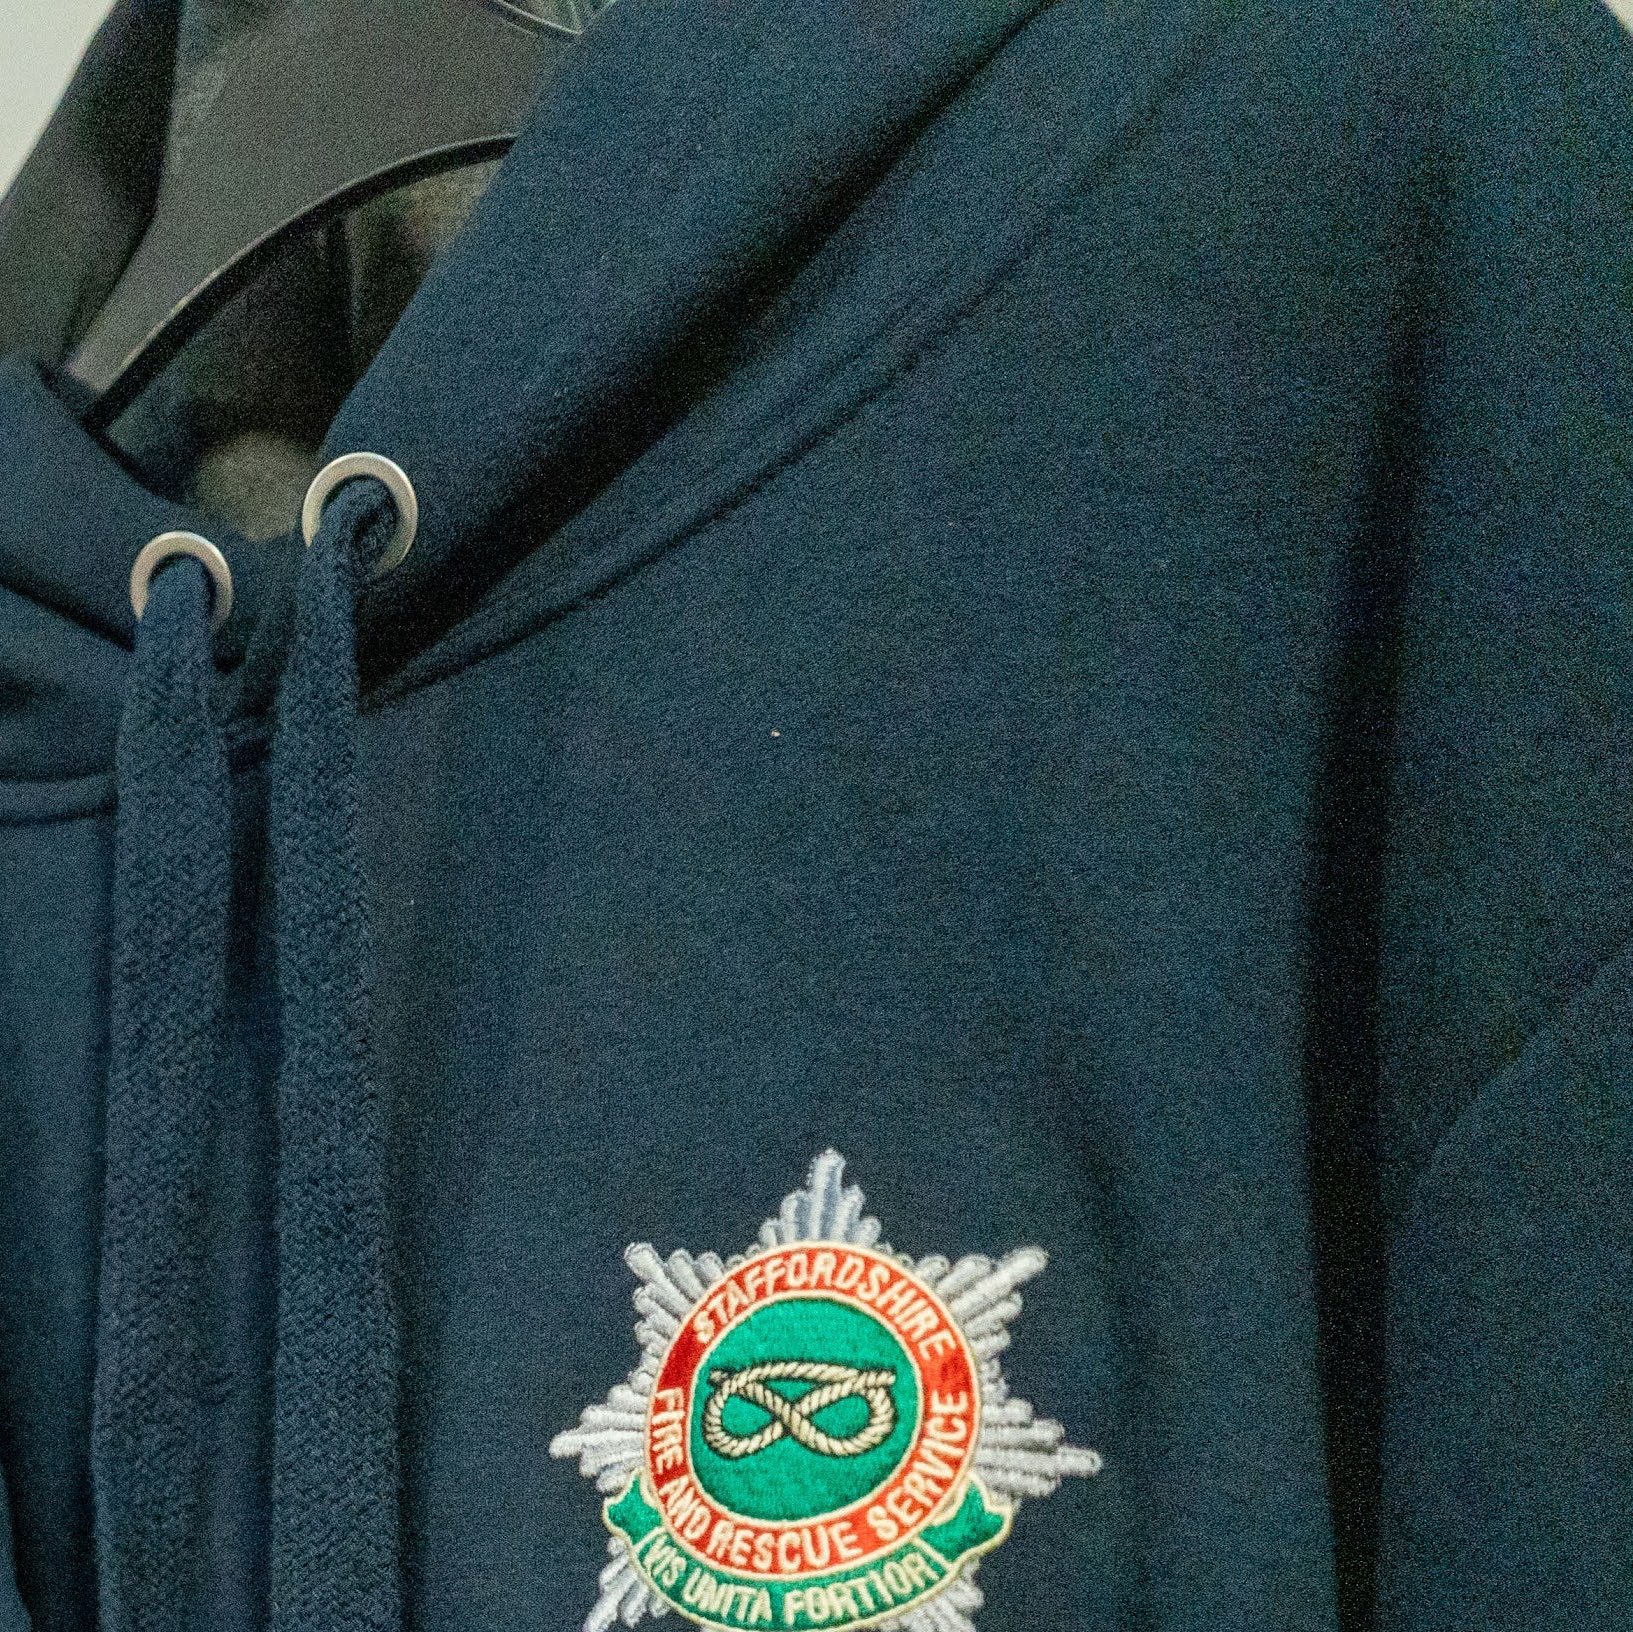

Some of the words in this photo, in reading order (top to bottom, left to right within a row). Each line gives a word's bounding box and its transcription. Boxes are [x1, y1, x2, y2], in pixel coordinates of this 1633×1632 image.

[693, 1252, 959, 1360] STAFFORDSHIRE
[654, 1388, 683, 1474] FIRE
[865, 1388, 969, 1540] SERVICE
[660, 1476, 709, 1540] AND
[710, 1520, 862, 1572] RESCUE
[645, 1541, 681, 1583] VIS
[683, 1571, 774, 1624] UNITA
[785, 1551, 940, 1625] FORTIOR
